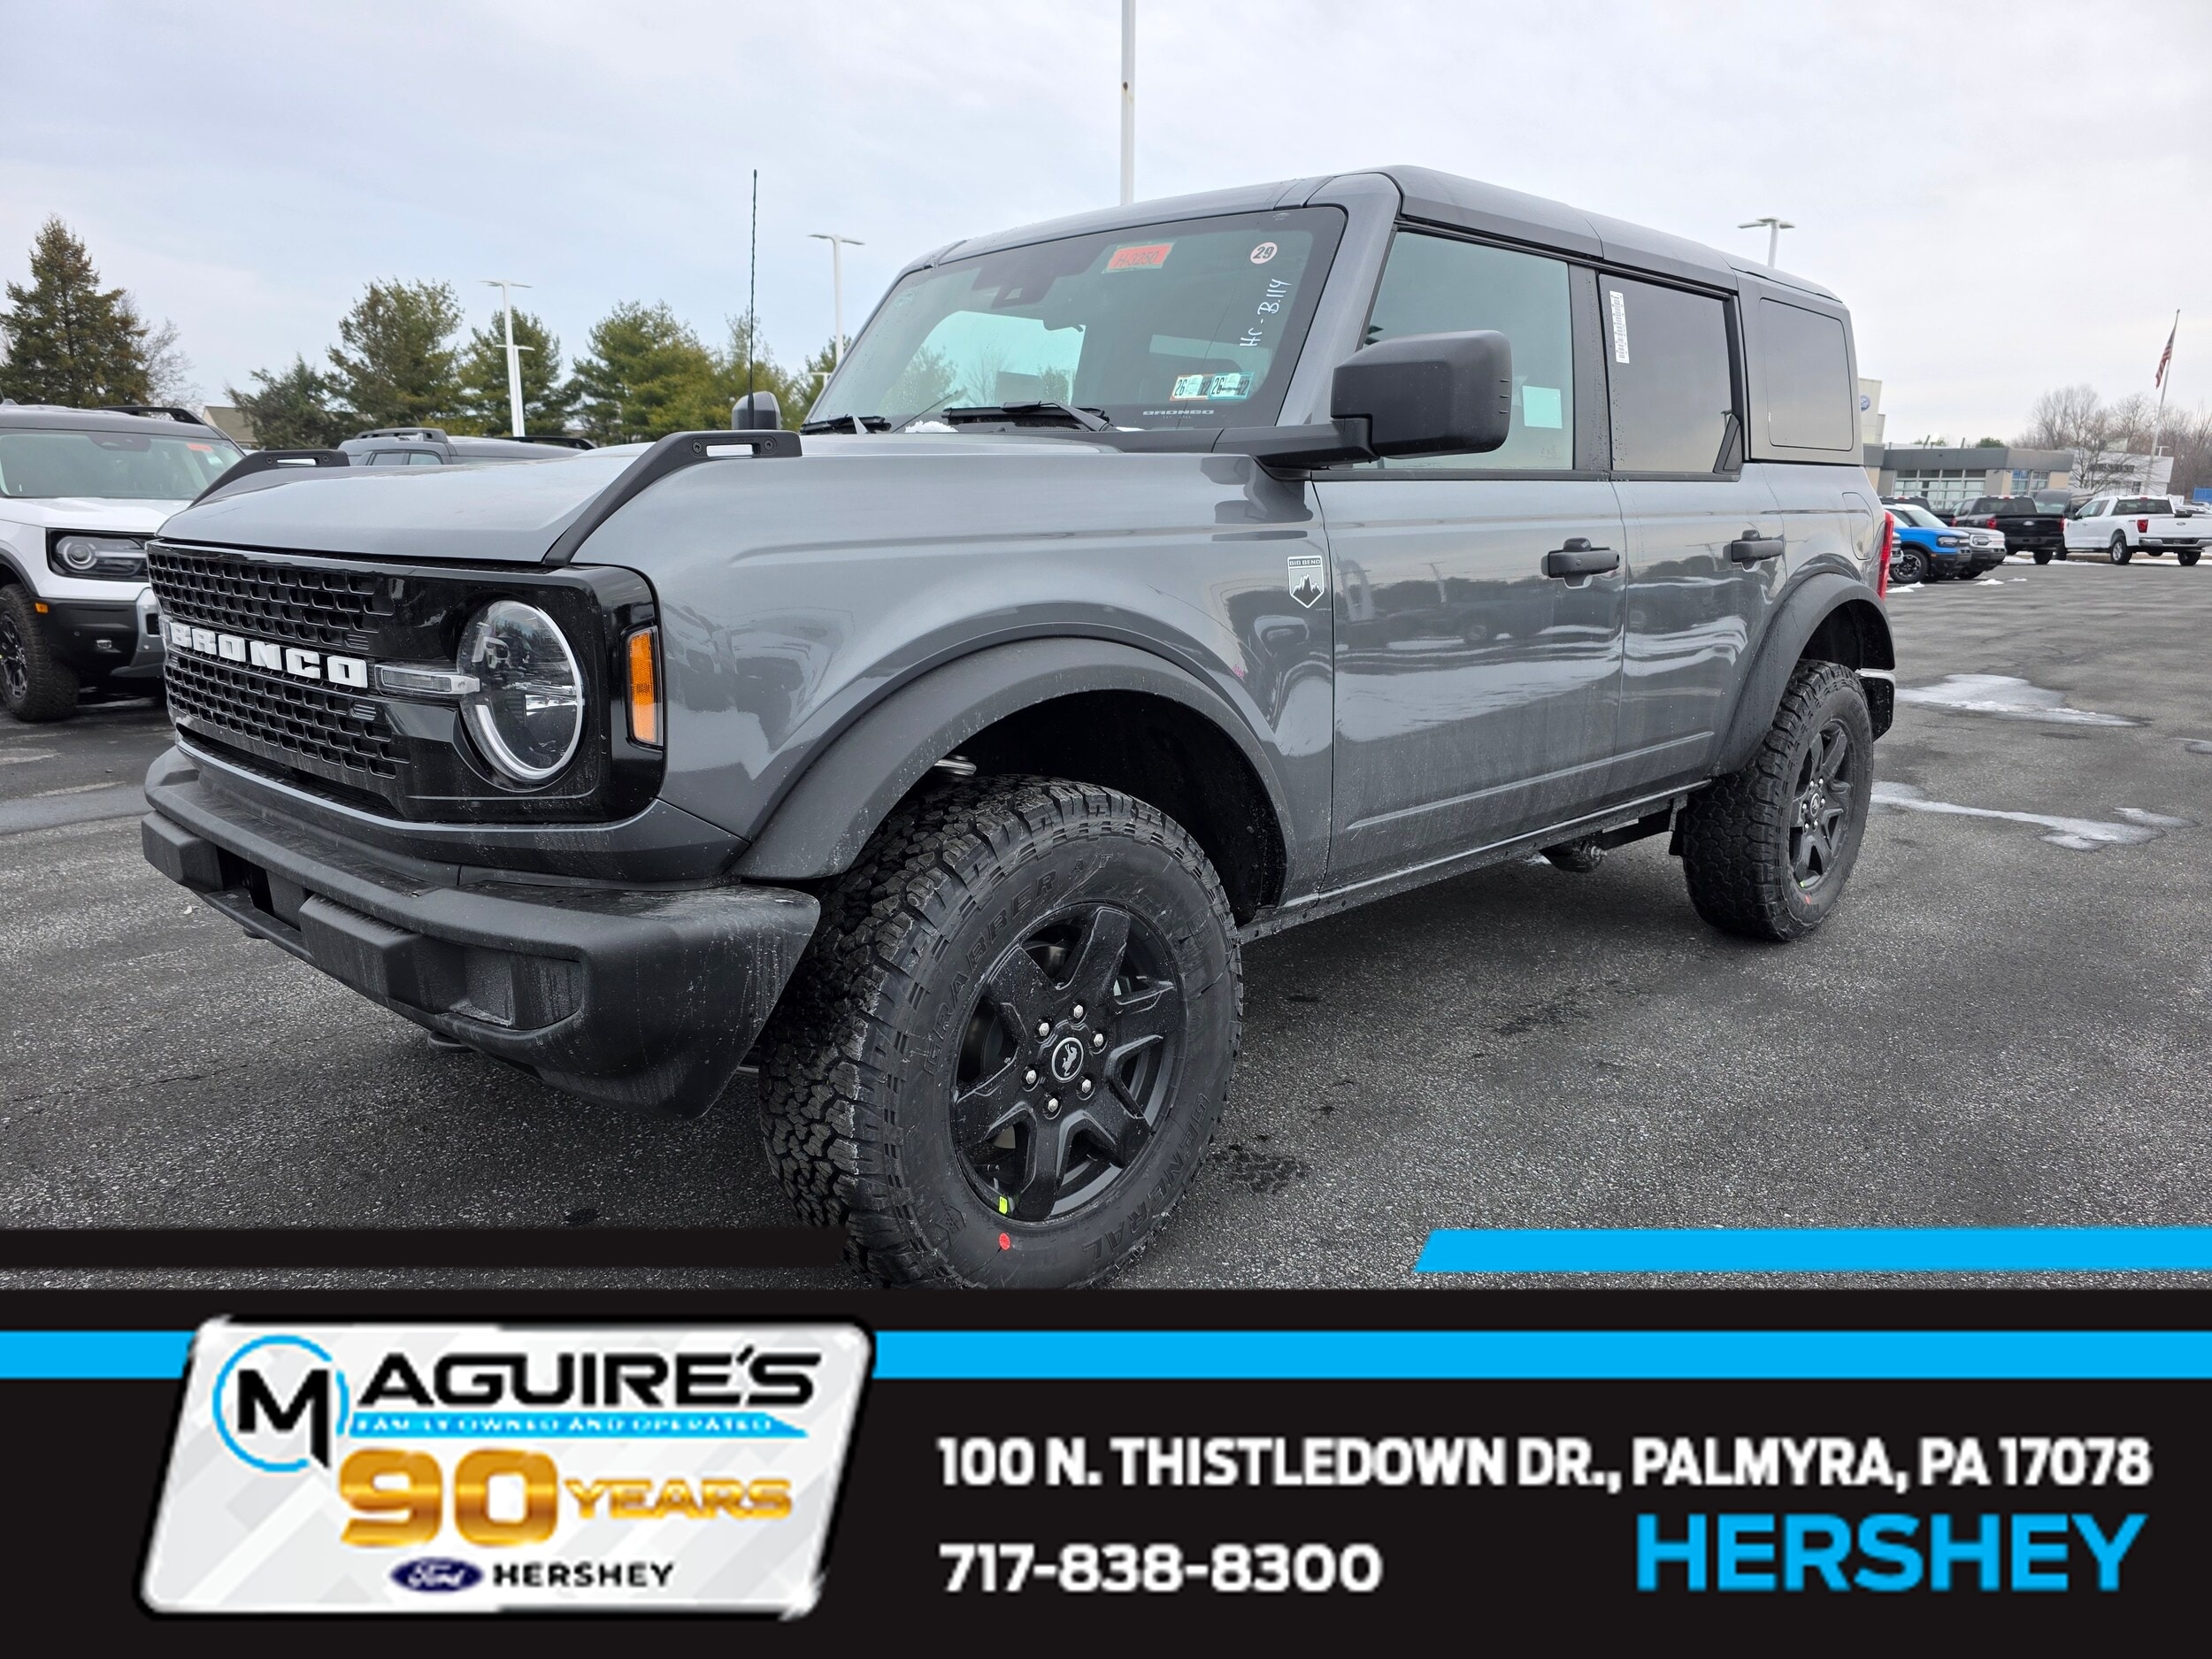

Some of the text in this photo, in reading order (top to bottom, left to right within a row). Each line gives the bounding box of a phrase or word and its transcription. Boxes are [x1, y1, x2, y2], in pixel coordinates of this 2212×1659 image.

[1253, 246, 1275, 259] 29
[1174, 379, 1212, 396] 26 12
[1211, 377, 1225, 396] 26
[169, 621, 369, 689] BRONCO
[923, 870, 1058, 1077] GRABBER
[1082, 1093, 1211, 1261] GENERAL
